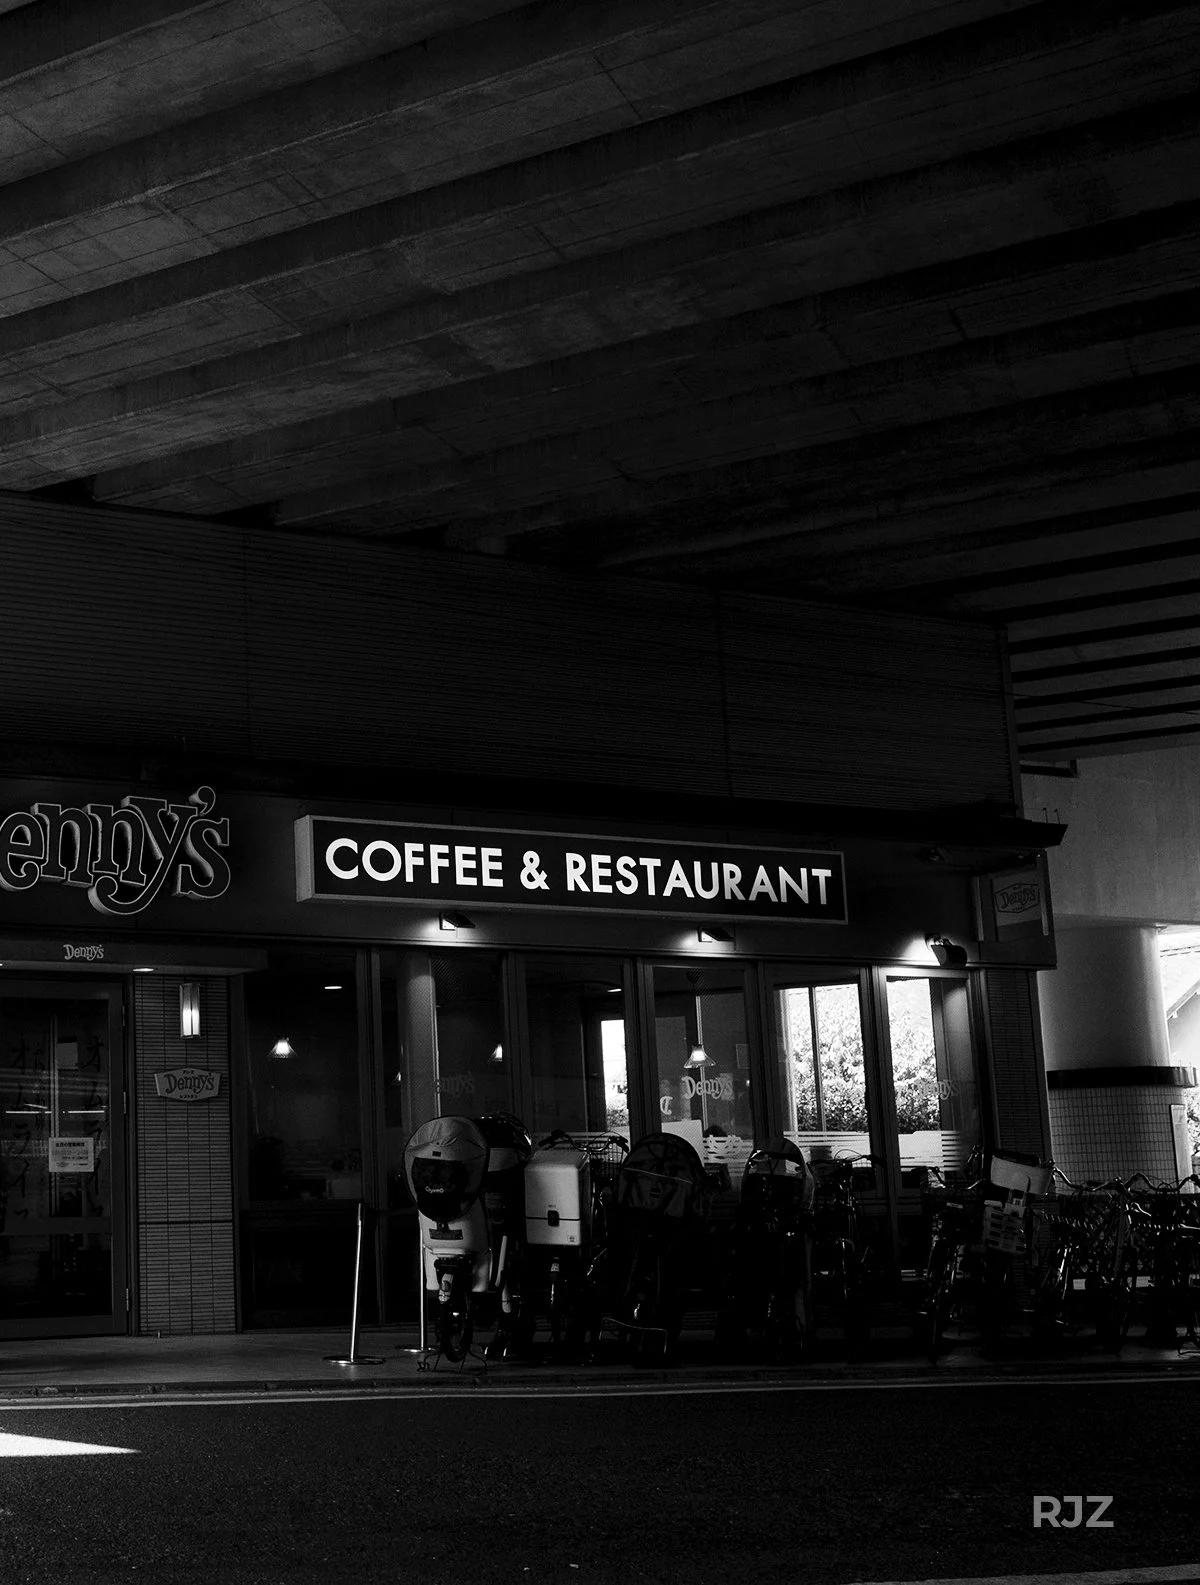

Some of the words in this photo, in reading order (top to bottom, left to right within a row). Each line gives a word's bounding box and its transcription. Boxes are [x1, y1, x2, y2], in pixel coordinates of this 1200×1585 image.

[325, 837, 504, 888] COFFEE
[519, 850, 550, 890] &
[565, 852, 833, 905] RESTAURANT
[63, 943, 105, 962] Denny's
[164, 1072, 215, 1095] Denny's
[681, 1075, 733, 1100] Dennys
